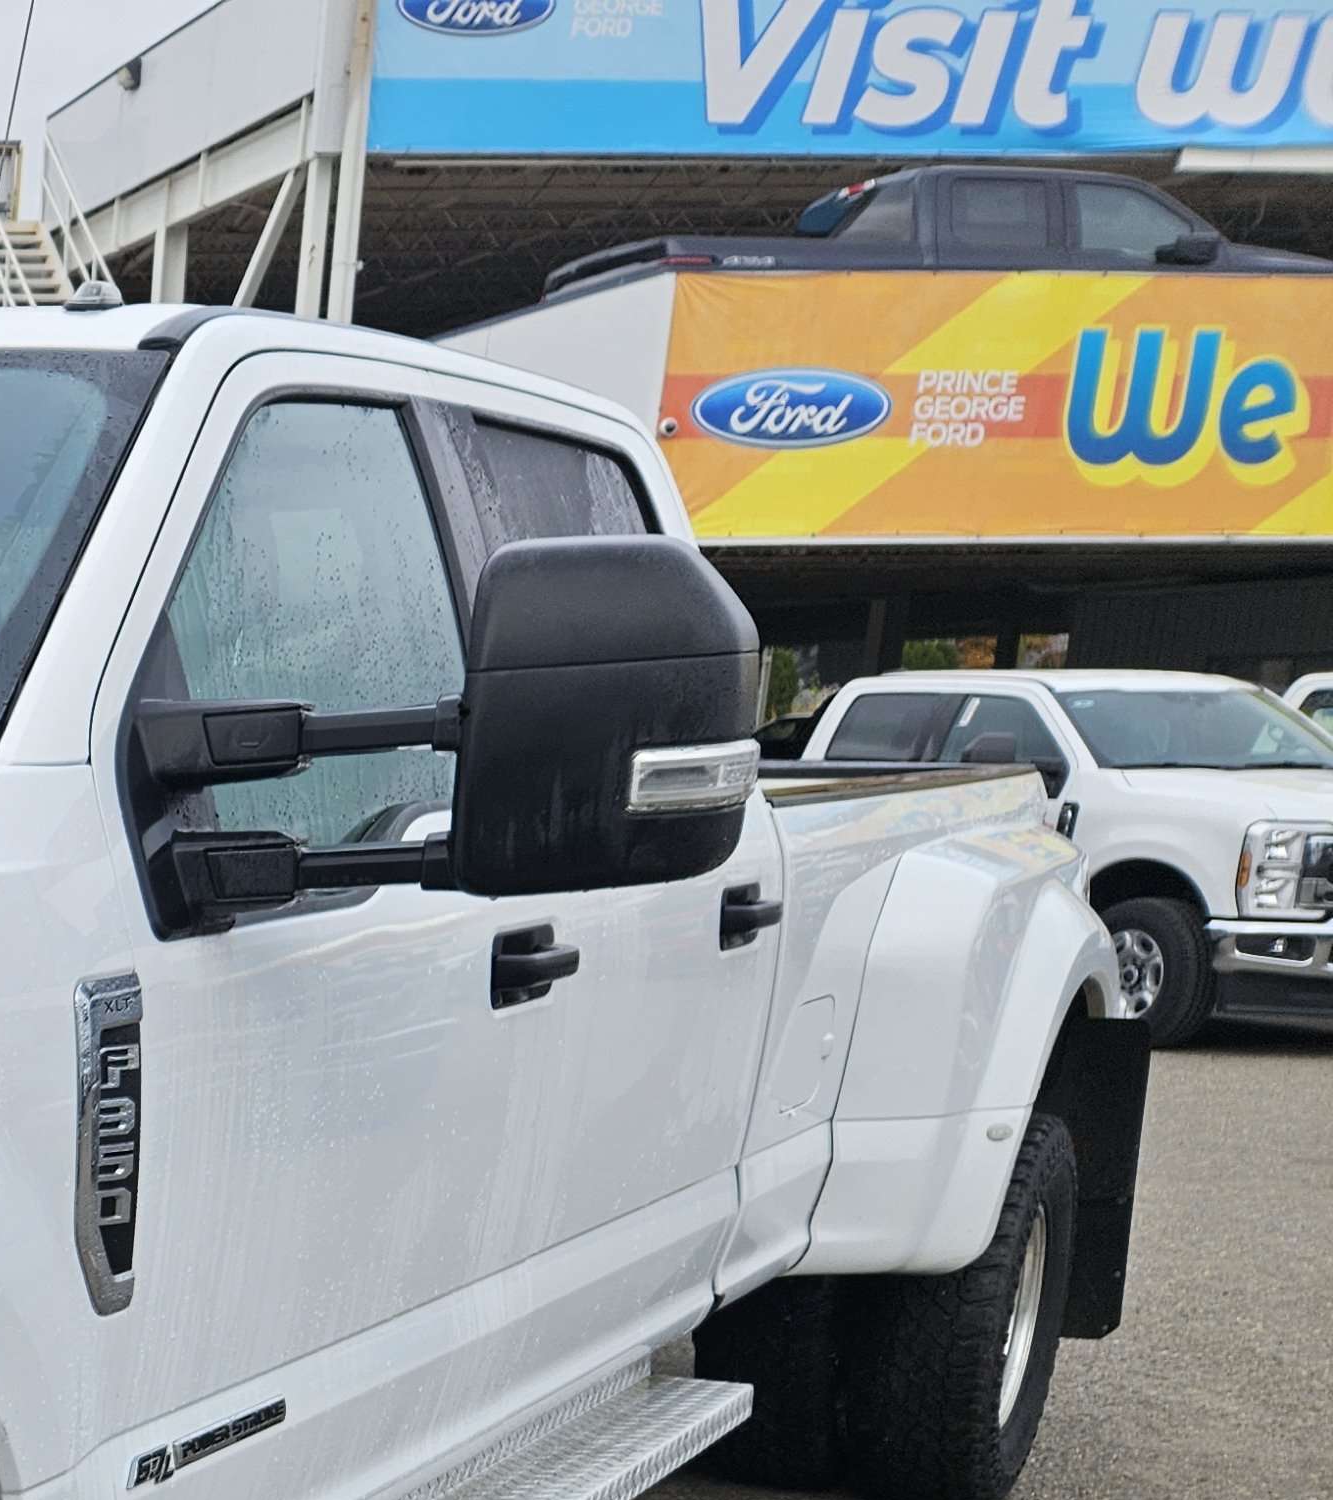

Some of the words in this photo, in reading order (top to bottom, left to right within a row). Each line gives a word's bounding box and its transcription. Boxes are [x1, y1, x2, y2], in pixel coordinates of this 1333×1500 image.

[426, 0, 521, 26] Ford
[570, 17, 632, 39] FORD
[700, 0, 1098, 128] Visit
[916, 369, 1018, 395] PRINCE
[729, 379, 854, 435] Ford
[913, 395, 1026, 422] GEORGE
[1067, 327, 1297, 466] We
[908, 422, 986, 448] FORD
[103, 996, 132, 1014] XLT
